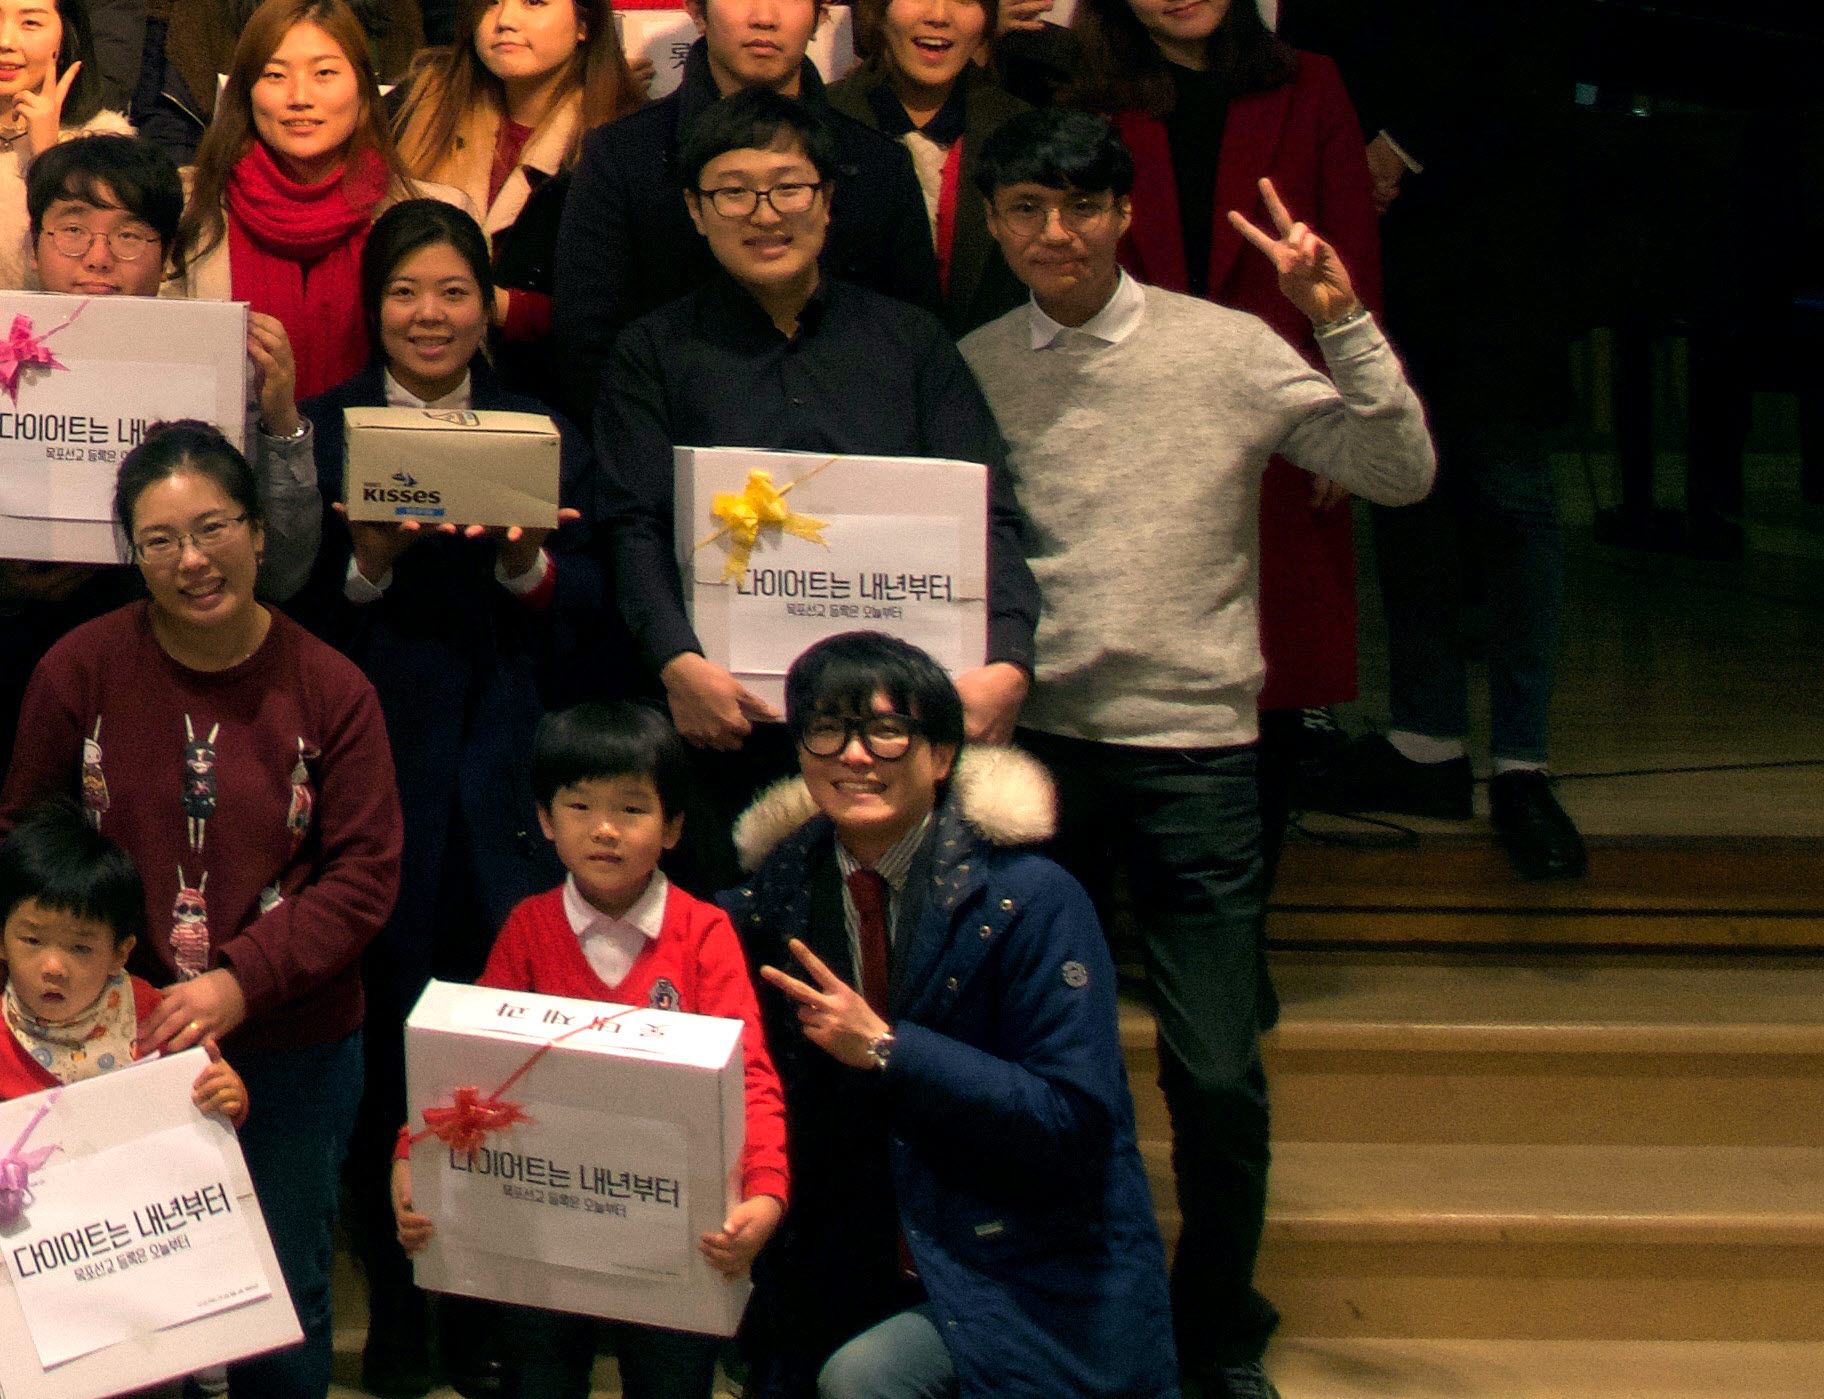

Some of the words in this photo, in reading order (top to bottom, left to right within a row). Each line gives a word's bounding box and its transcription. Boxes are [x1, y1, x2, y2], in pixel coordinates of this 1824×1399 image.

[0, 413, 108, 444] 다이어트는
[46, 448, 84, 462] 목포선교
[88, 449, 117, 463] 등록은
[737, 568, 851, 600] 다이어트는
[860, 572, 952, 602] 내년부터
[786, 603, 826, 616] 목포선교
[863, 605, 903, 618] 오늘부터
[449, 1144, 571, 1187] 다이어트는
[579, 1164, 680, 1208] 내년부터
[504, 1184, 545, 1203] 목포선교
[583, 1197, 627, 1218] 오늘부터
[14, 1219, 131, 1278] 다이어트는
[133, 1182, 231, 1237] 내년부터
[74, 1258, 115, 1282] 목포선교
[117, 1245, 149, 1272] 등록은
[149, 1233, 191, 1261] 오늘부터
